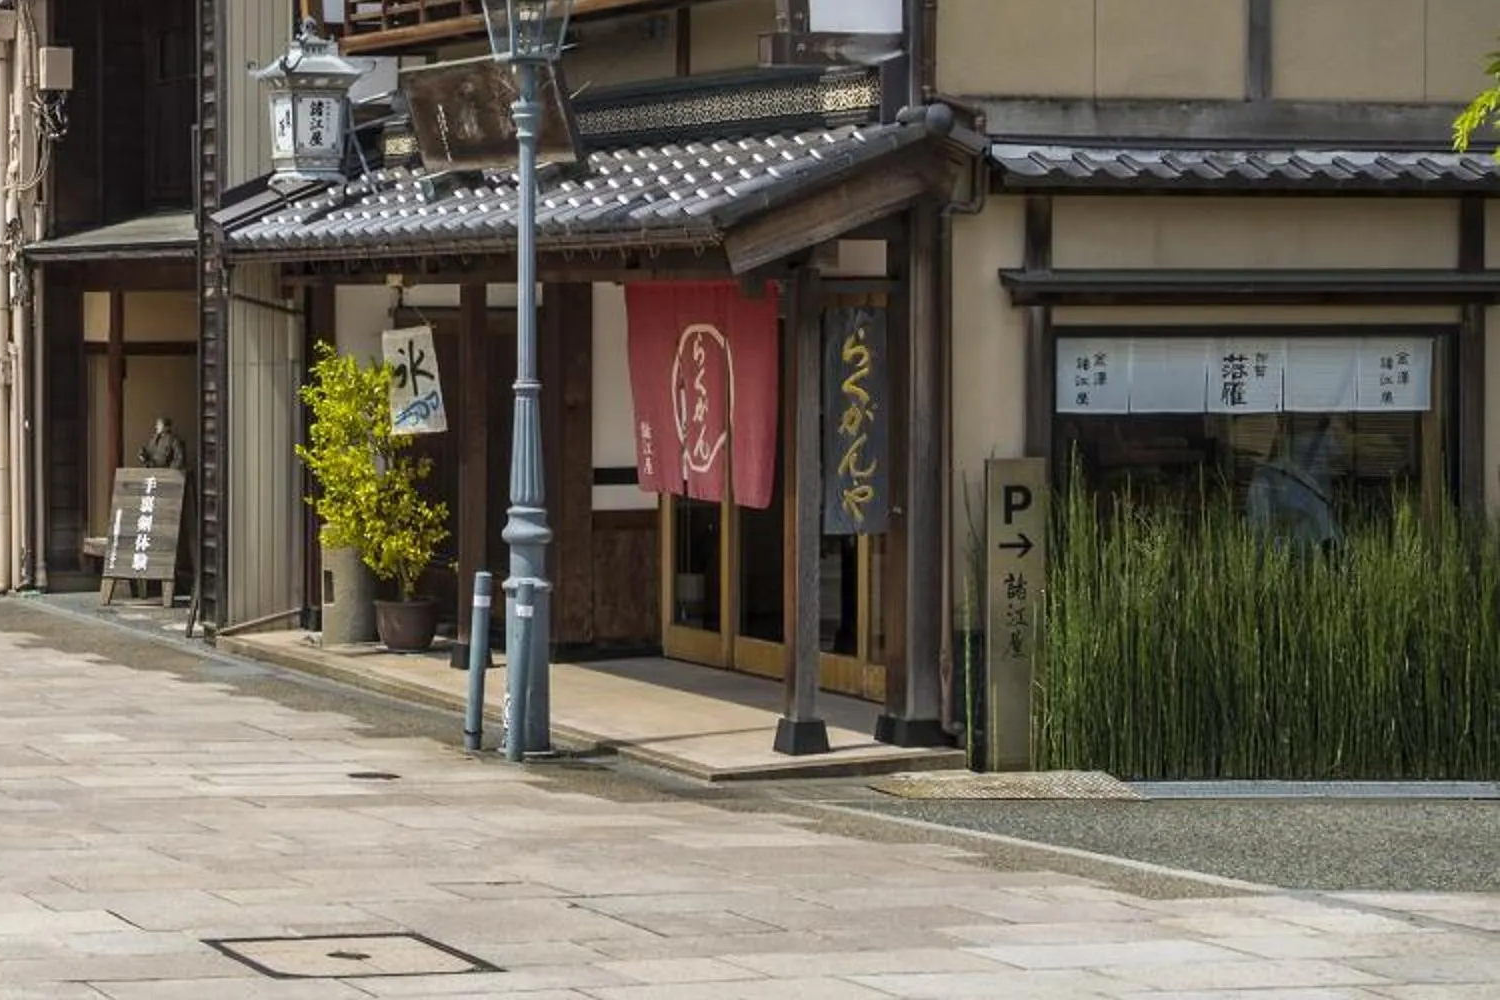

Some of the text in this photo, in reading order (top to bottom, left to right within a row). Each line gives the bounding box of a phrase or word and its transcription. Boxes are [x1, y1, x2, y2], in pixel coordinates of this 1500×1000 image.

[393, 339, 436, 397] 氷
[692, 330, 710, 462] らくがん
[1221, 353, 1249, 407] 落雁
[838, 326, 879, 523] らくがんや
[1003, 484, 1033, 526] P
